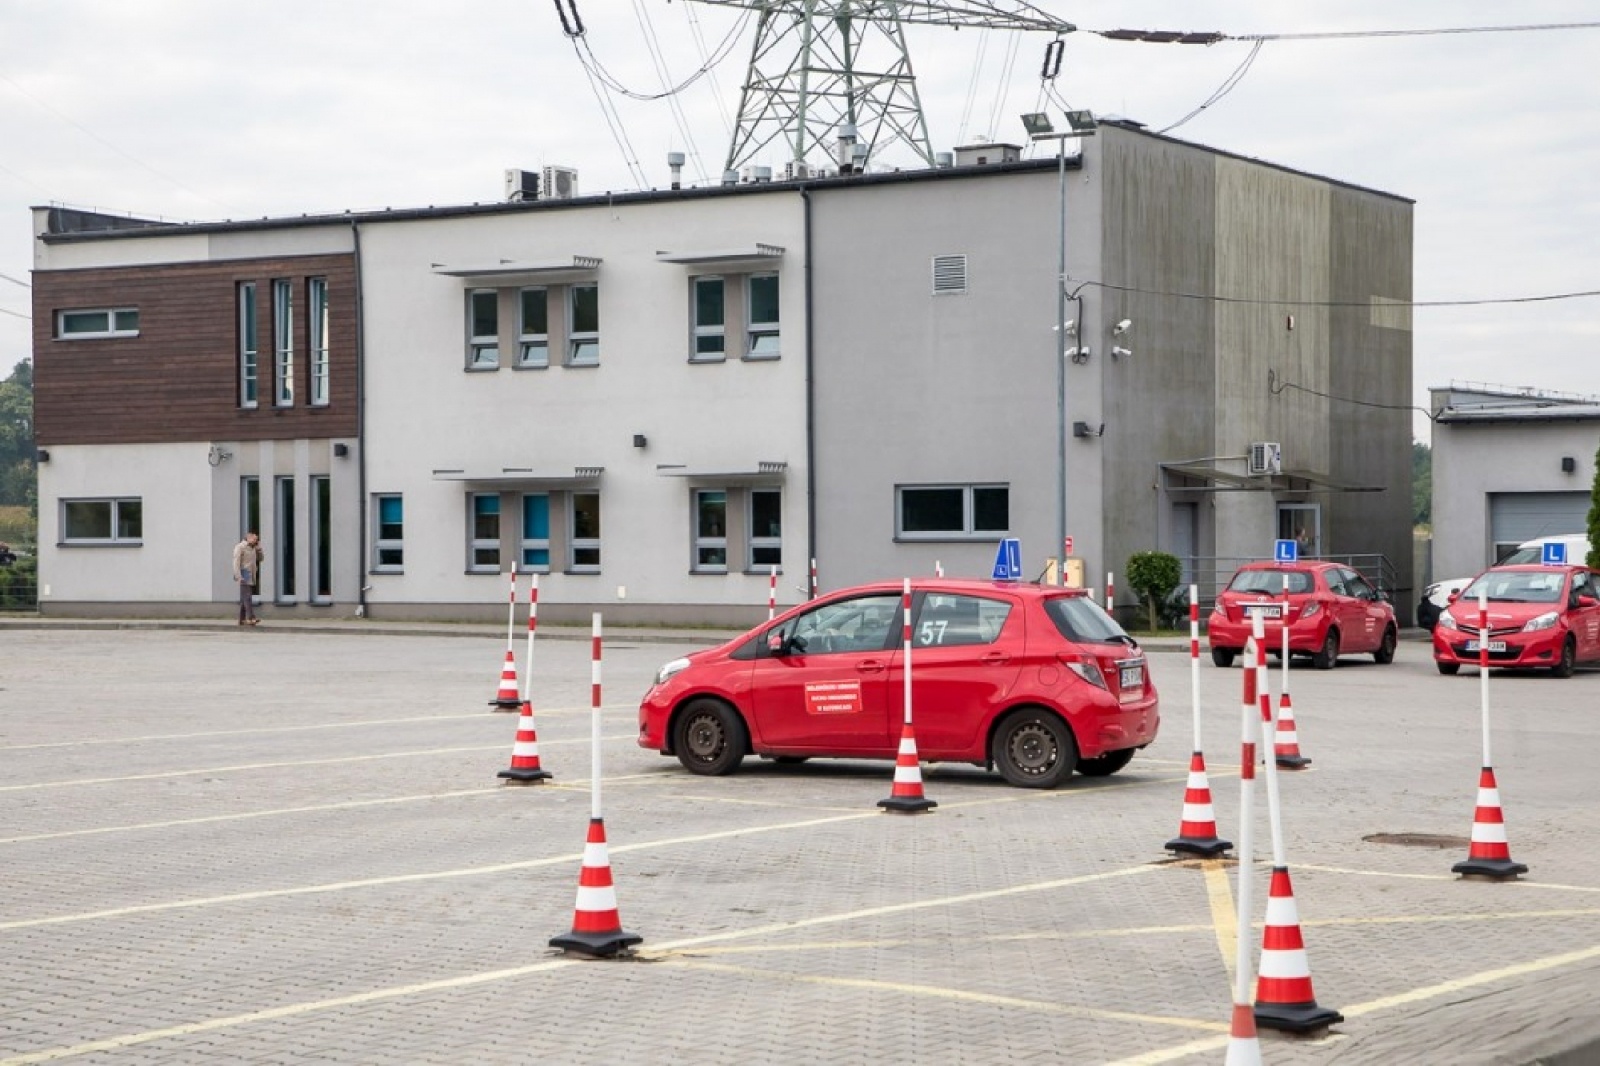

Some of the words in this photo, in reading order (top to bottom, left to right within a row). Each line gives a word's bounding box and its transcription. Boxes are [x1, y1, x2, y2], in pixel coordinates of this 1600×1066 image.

[1010, 545, 1019, 572] L
[1281, 543, 1291, 558] L
[1549, 545, 1560, 560] L
[921, 620, 948, 644] 57
